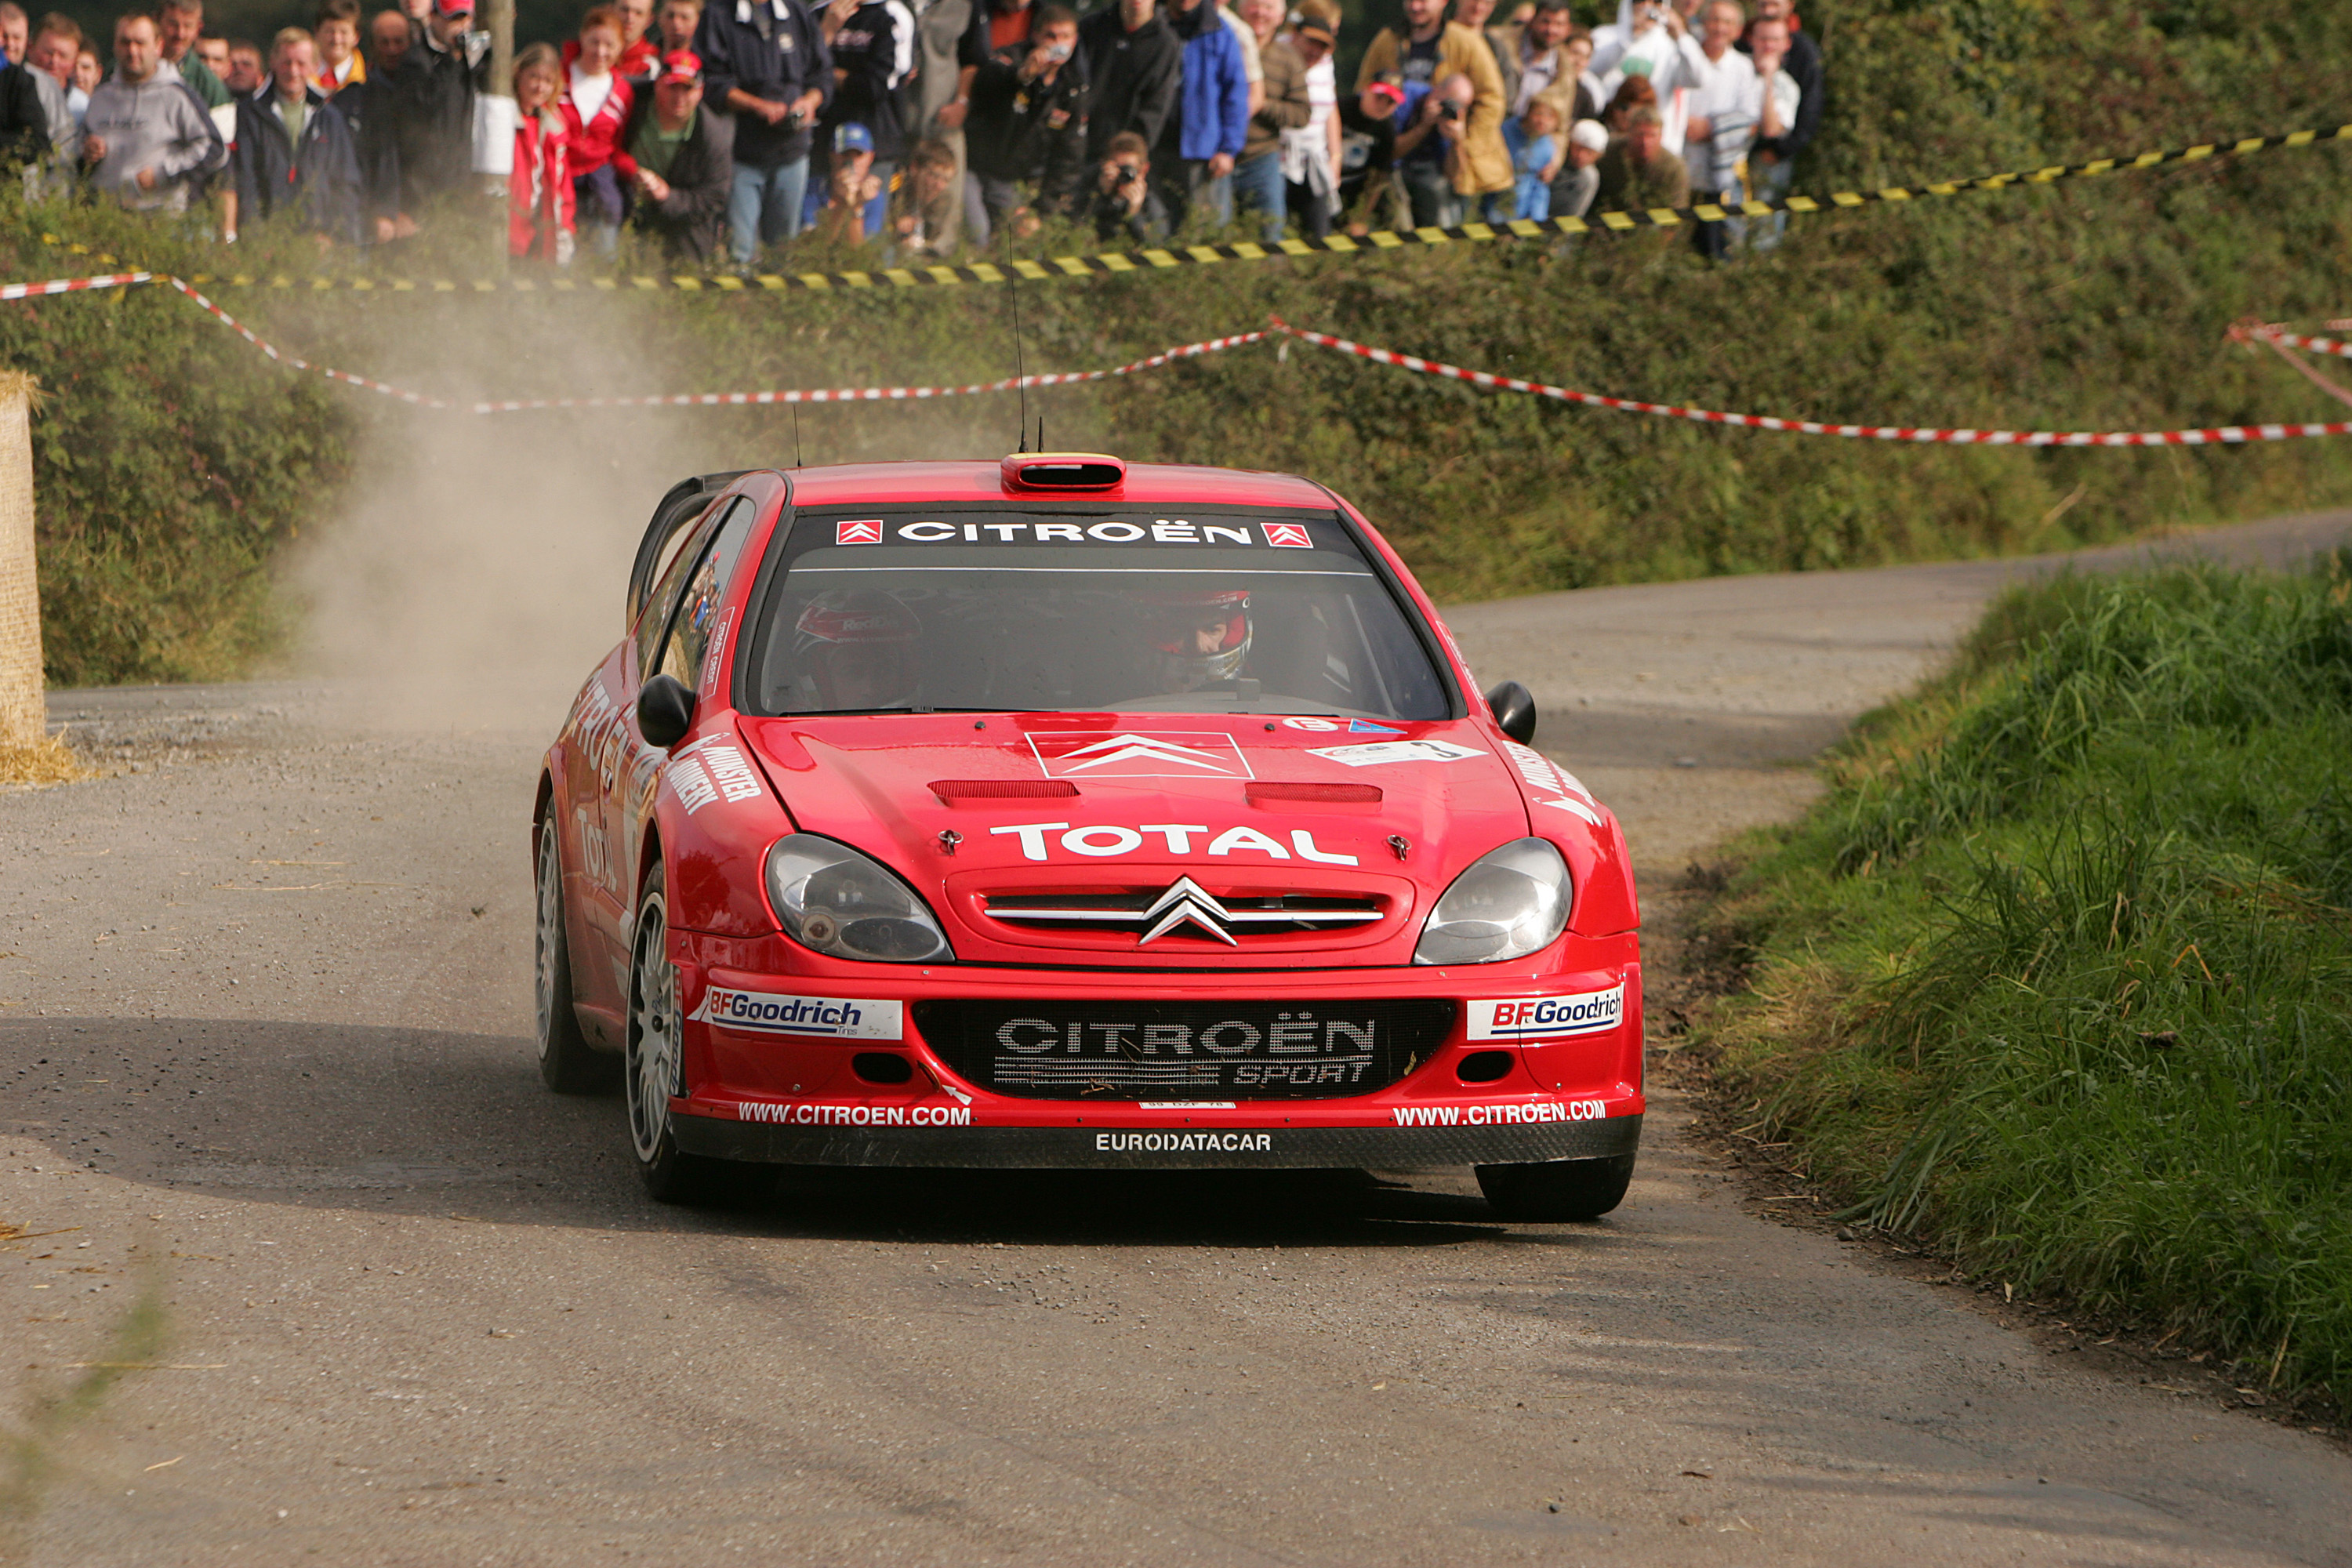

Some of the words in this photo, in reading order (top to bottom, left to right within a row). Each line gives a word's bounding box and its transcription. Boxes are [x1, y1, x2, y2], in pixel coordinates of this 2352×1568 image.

[898, 518, 1253, 545] CITROËN
[667, 757, 720, 816] JOINERY
[700, 746, 762, 804] MUNSTER
[577, 807, 617, 893] TOTAL
[989, 822, 1359, 866] TOTAL
[710, 990, 862, 1026] BFGoodrich
[1492, 991, 1621, 1025] BFGoodrich
[995, 1011, 1376, 1054] CITROËN
[1233, 1062, 1371, 1085] SPORT
[738, 1102, 971, 1127] WWW.CITROEN.COM
[1393, 1100, 1607, 1127] WWW.CITROEN.COM
[1095, 1133, 1272, 1152] EURODATACAR
